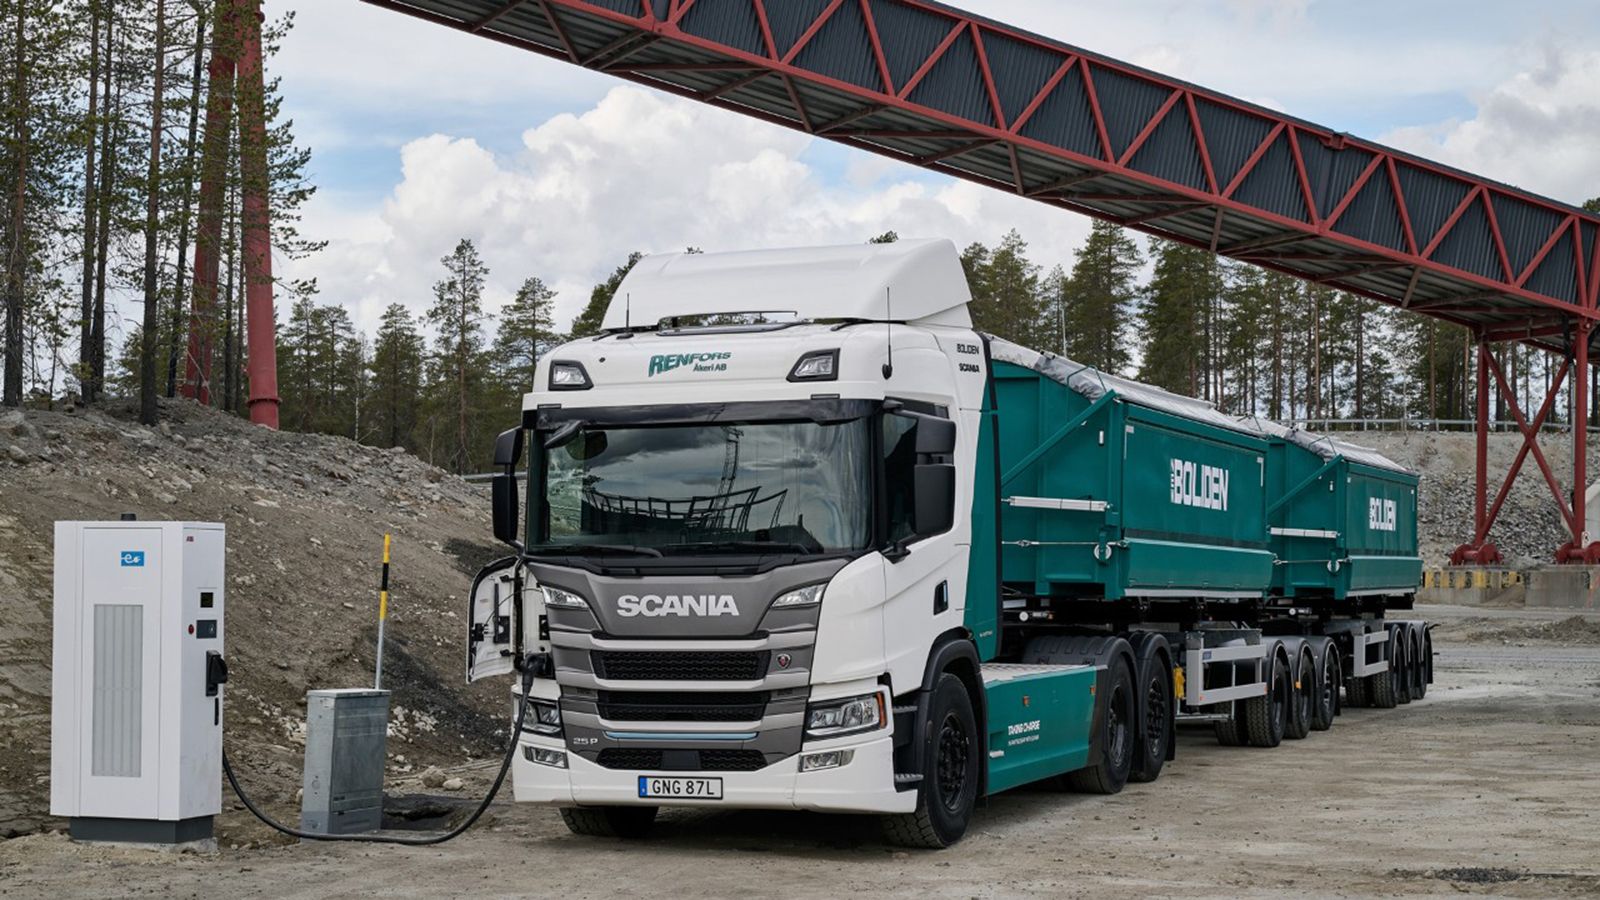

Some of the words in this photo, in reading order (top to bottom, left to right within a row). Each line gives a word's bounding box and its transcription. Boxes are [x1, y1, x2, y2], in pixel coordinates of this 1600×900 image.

[956, 343, 980, 355] BOLIDEN
[648, 352, 732, 378] RENFORS
[693, 363, 715, 372] Åkeri
[714, 363, 727, 371] AB
[958, 362, 981, 373] SCANIA
[1174, 458, 1229, 511] BOLIDEN
[1370, 496, 1397, 532] BOLIDEN
[616, 594, 740, 617] SCANIA
[652, 779, 681, 795] GNG
[685, 780, 715, 796] 87L
